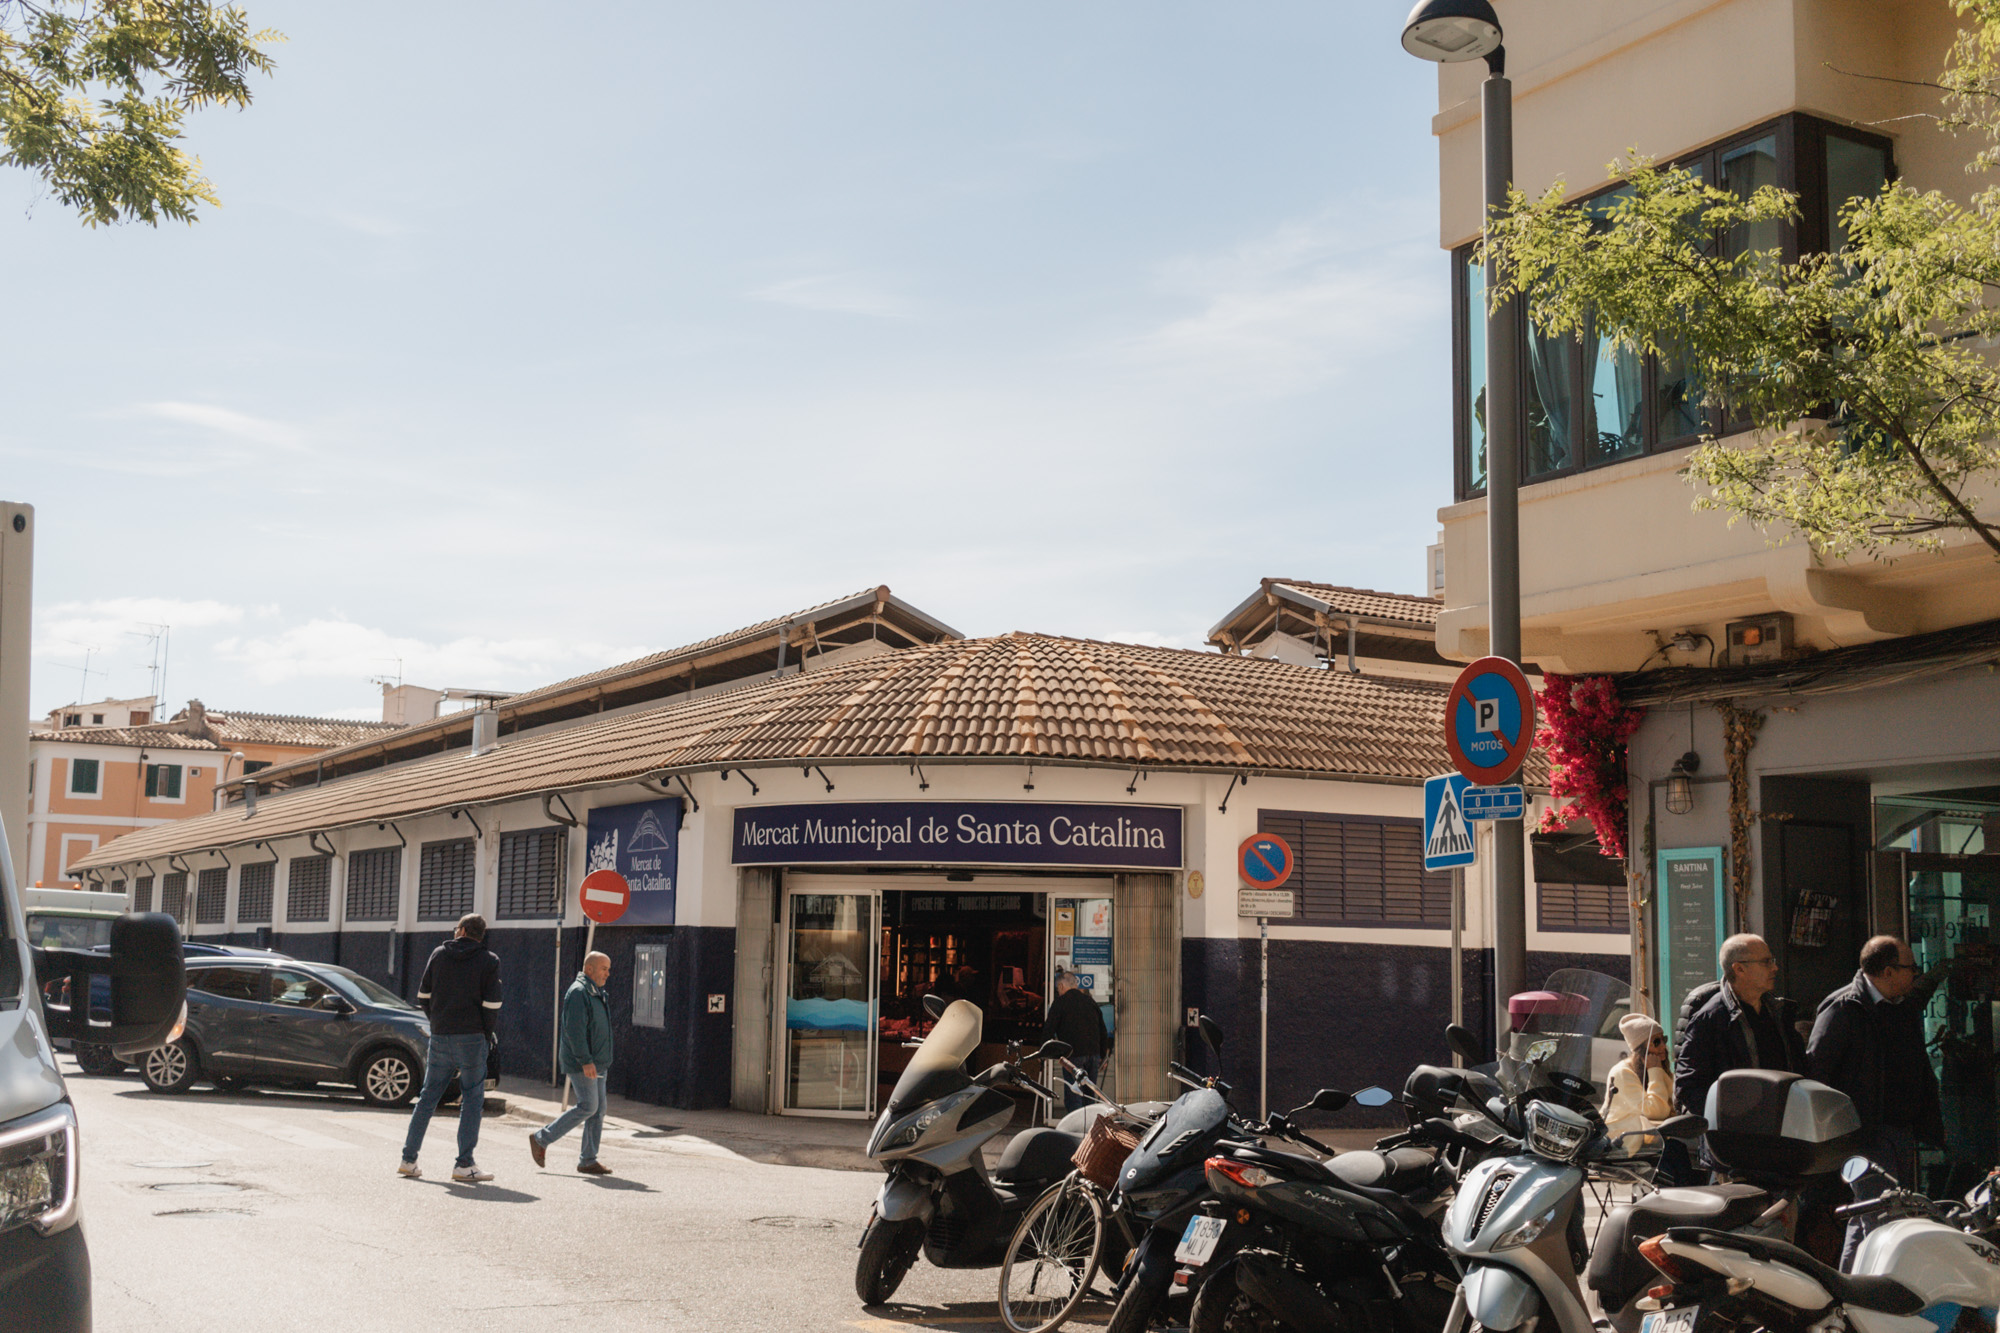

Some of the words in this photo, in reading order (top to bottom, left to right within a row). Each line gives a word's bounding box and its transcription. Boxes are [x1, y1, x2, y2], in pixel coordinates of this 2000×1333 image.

[1480, 703, 1494, 728] P
[1471, 739, 1504, 752] MOTOS
[742, 819, 799, 846] Mercat
[803, 816, 912, 850] Municipal
[919, 816, 949, 844] de
[956, 813, 1042, 845] Santa
[1049, 815, 1165, 849] Catalina
[631, 856, 653, 871] Mercat
[653, 854, 662, 870] de
[1673, 863, 1708, 872] SANTINA
[642, 872, 671, 891] Catalina
[1562, 1078, 1581, 1089] GIVI
[1184, 1237, 1208, 1256] MLV
